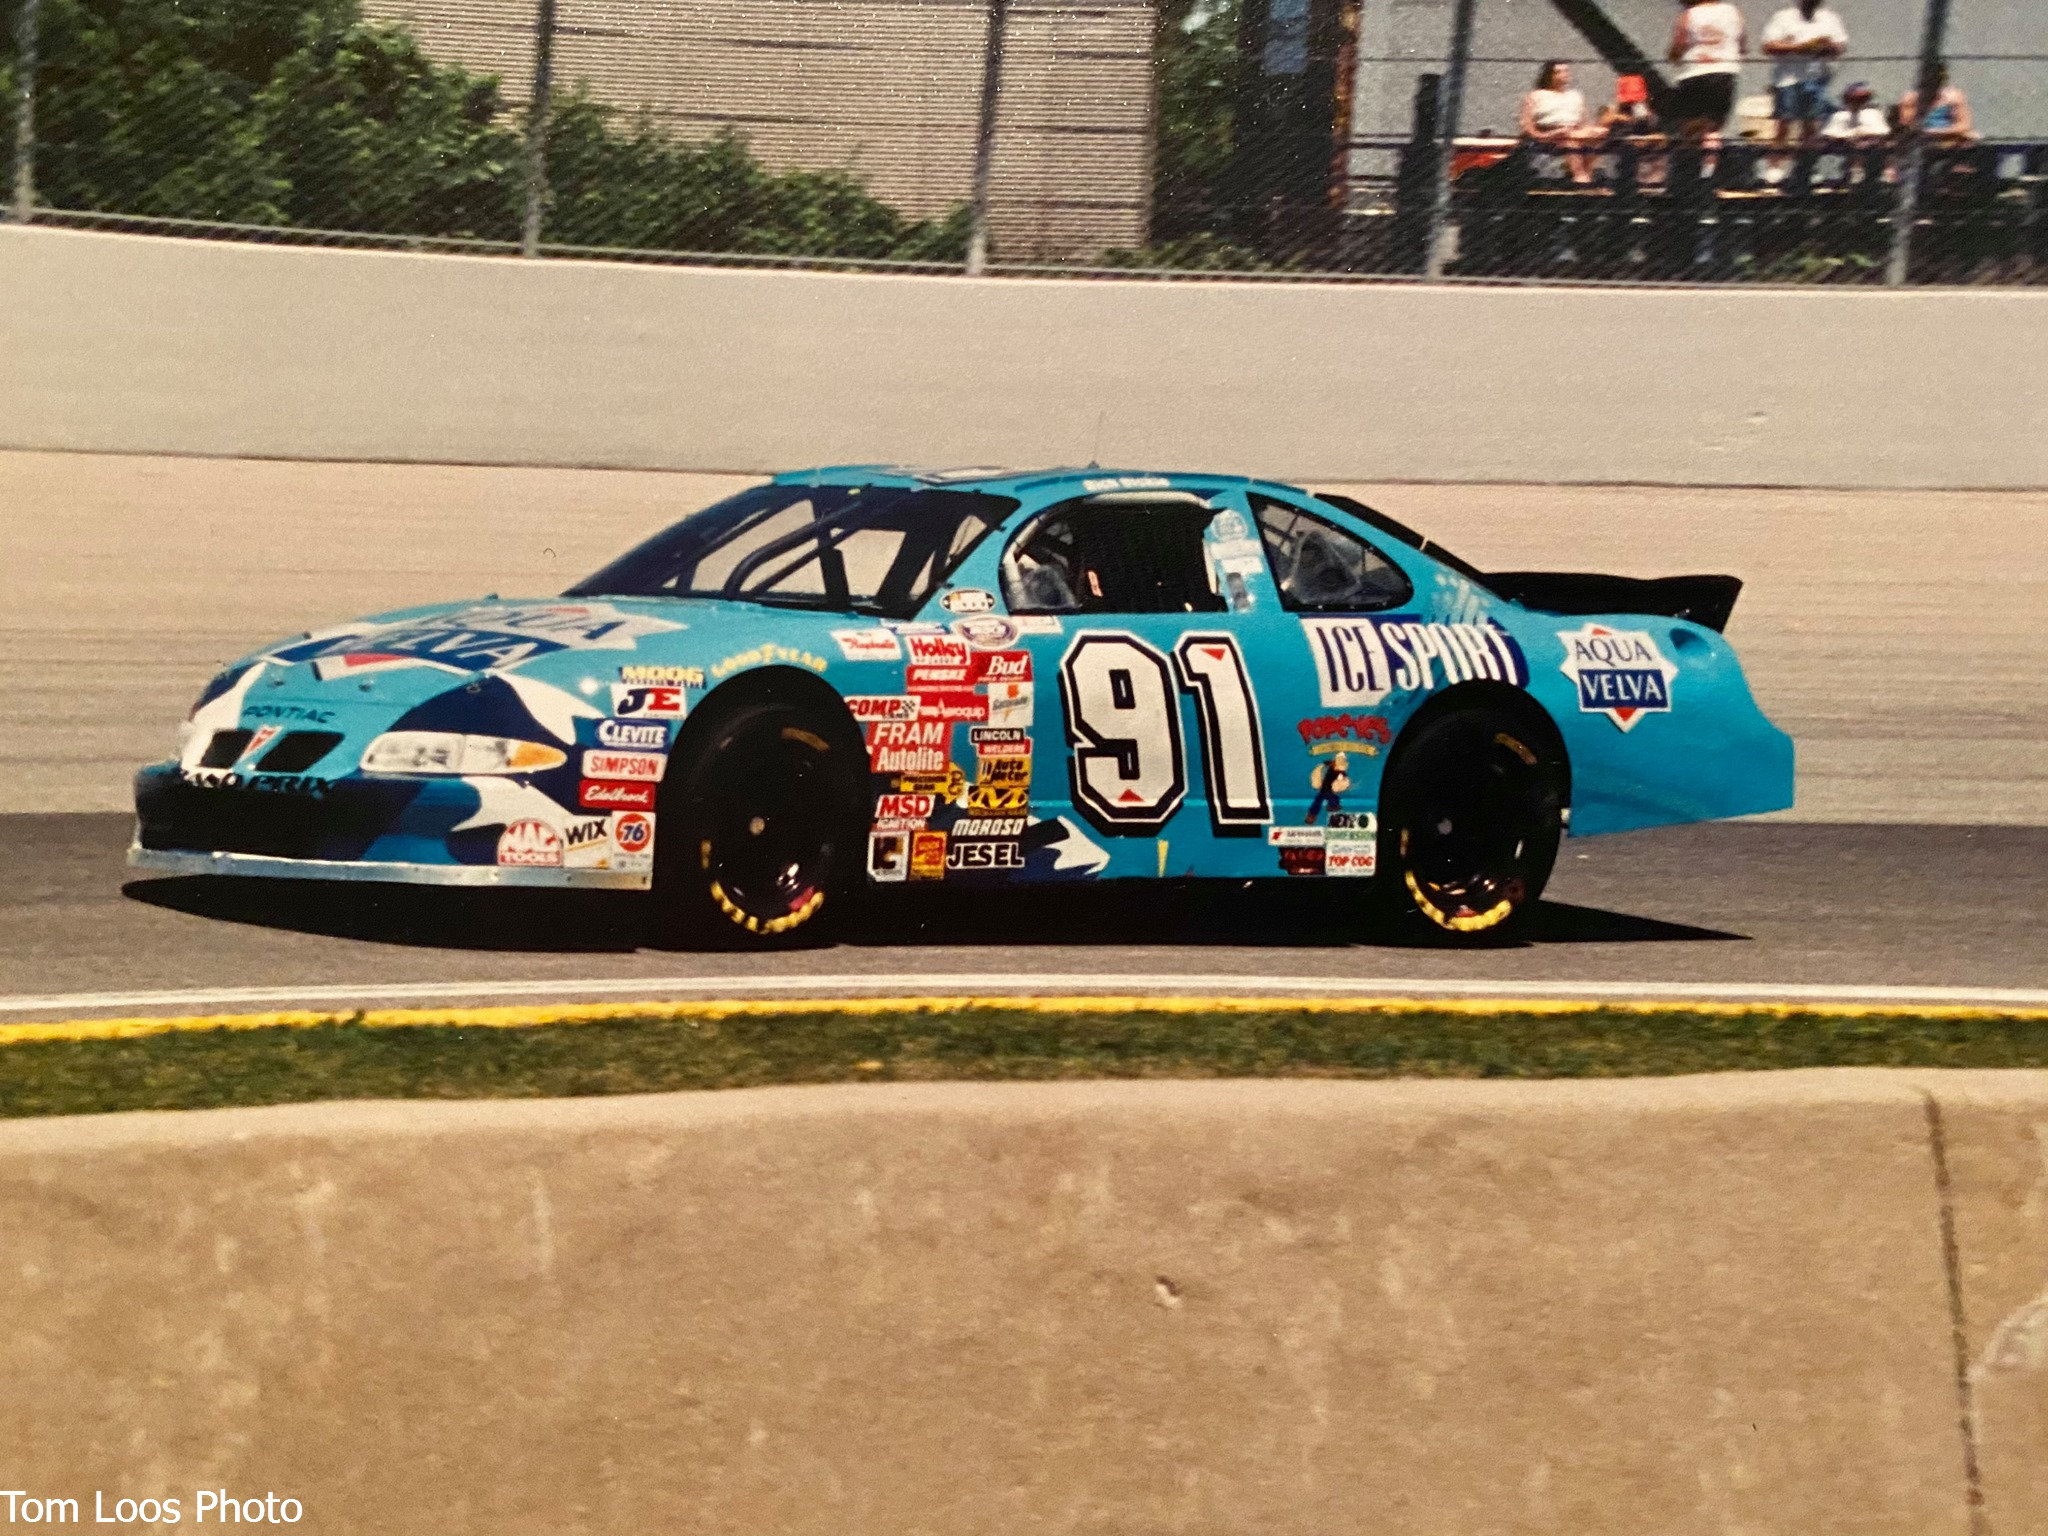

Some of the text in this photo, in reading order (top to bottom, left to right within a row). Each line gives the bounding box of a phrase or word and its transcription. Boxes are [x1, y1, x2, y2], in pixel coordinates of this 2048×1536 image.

[910, 637, 967, 665] Holley
[1315, 621, 1519, 693] ICE SPORT
[1574, 636, 1653, 667] AQUA
[621, 666, 705, 682] MOOG
[987, 655, 1029, 675] Bud
[1581, 673, 1664, 702] VELVA
[617, 687, 681, 715] JE
[846, 699, 901, 716] COMP
[243, 705, 337, 724] PONTIAC
[597, 719, 667, 745] CLEVITE
[874, 722, 945, 745] FRAM
[973, 730, 1022, 742] LINCOLN
[1059, 629, 1273, 836] 91
[590, 756, 658, 775] SIMPSON
[877, 746, 944, 772] Autolite
[995, 759, 1023, 770] Auto
[879, 795, 931, 818] MSD
[565, 818, 608, 845] WIX
[622, 822, 645, 842] 76
[952, 819, 1025, 836] MOROSO
[946, 842, 1026, 869] JESEL
